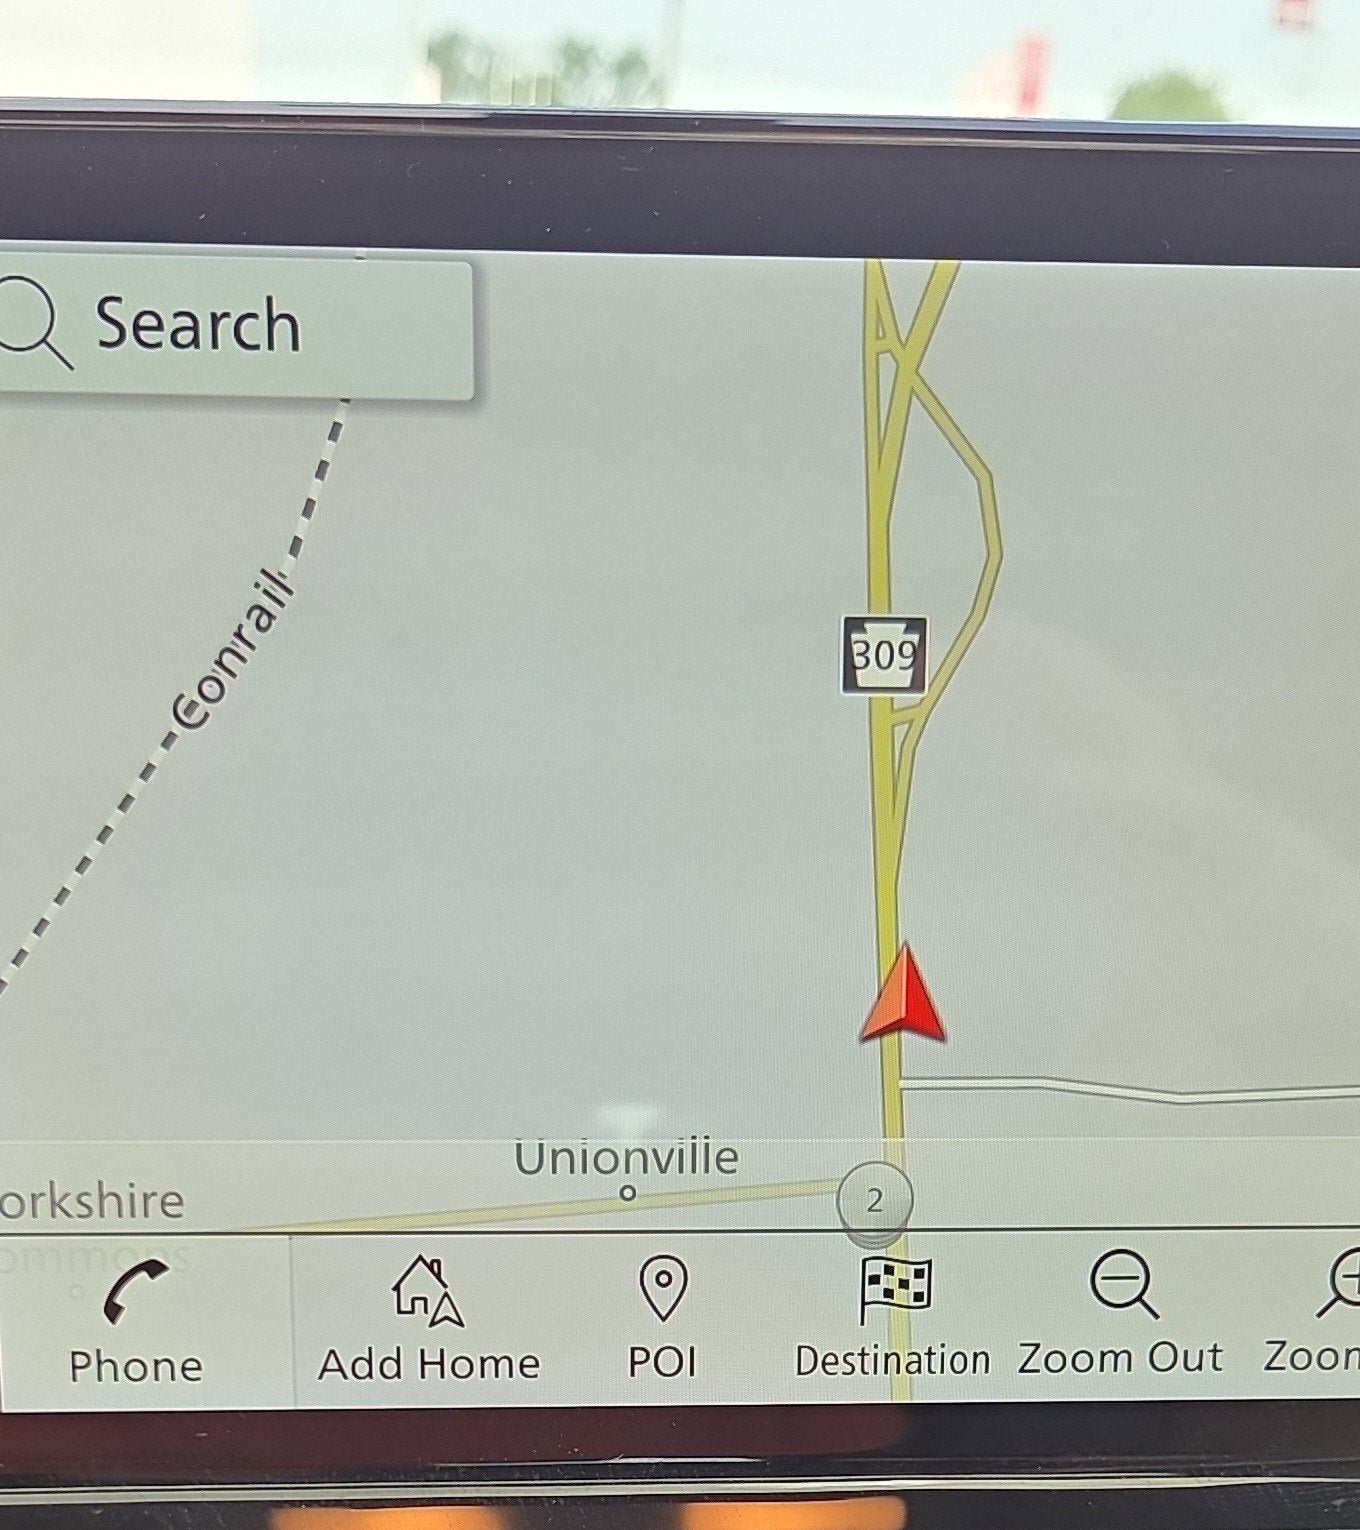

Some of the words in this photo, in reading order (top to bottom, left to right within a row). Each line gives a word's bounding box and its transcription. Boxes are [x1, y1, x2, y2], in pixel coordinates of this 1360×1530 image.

[97, 294, 302, 352] Search
[171, 567, 295, 731] Conrail
[853, 639, 918, 670] 309
[515, 1136, 740, 1177] Unionville
[866, 1188, 884, 1213] 2
[70, 1348, 204, 1383] Phone
[317, 1345, 402, 1381] Add
[419, 1347, 541, 1380] Home
[629, 1345, 696, 1378] POI
[796, 1344, 990, 1376] Destination
[1018, 1342, 1134, 1374] Zoom
[1148, 1341, 1223, 1373] Out
